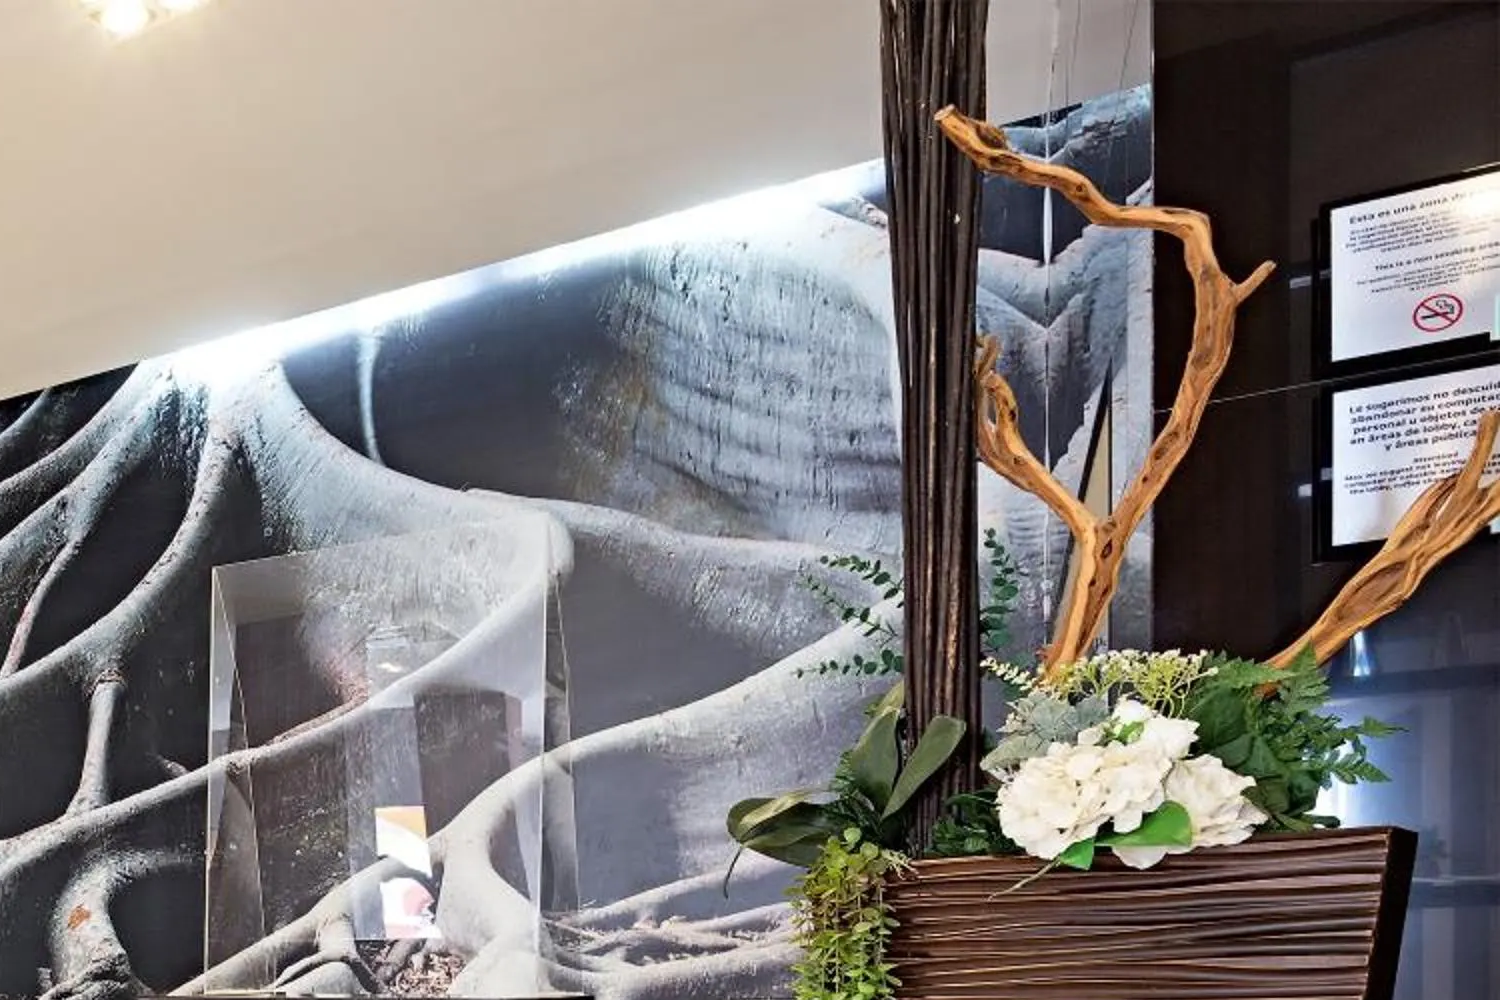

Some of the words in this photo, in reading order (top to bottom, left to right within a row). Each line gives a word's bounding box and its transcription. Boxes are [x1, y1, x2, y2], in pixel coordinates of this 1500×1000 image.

[1365, 394, 1431, 411] sugerimos
[1433, 390, 1449, 400] no
[1350, 407, 1417, 424] abandonar
[1353, 417, 1407, 436] personal
